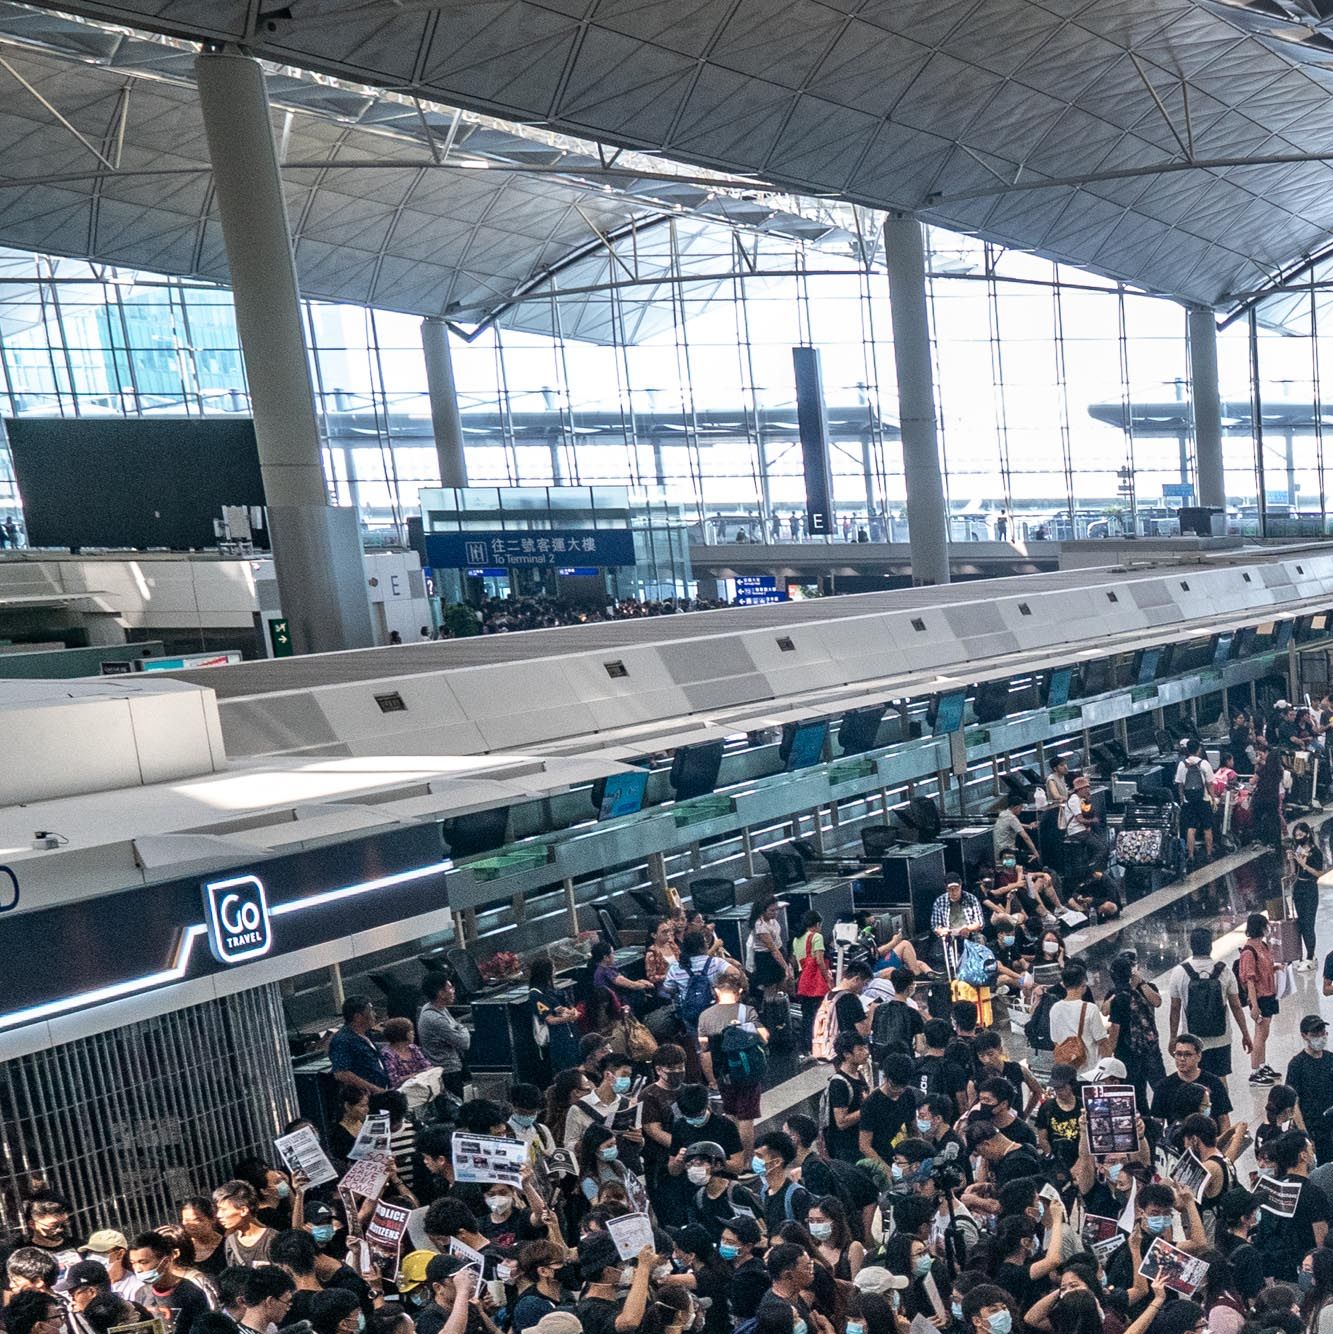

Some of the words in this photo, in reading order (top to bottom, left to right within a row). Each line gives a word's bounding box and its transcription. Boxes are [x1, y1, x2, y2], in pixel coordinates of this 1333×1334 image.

[813, 513, 823, 528] E
[492, 538, 597, 554] 往二號客運大樓
[494, 554, 506, 564] To
[507, 553, 545, 564] Terminal
[549, 554, 555, 565] 2
[391, 575, 401, 596] E
[220, 893, 260, 934] Go
[226, 931, 262, 949] TRAVEL
